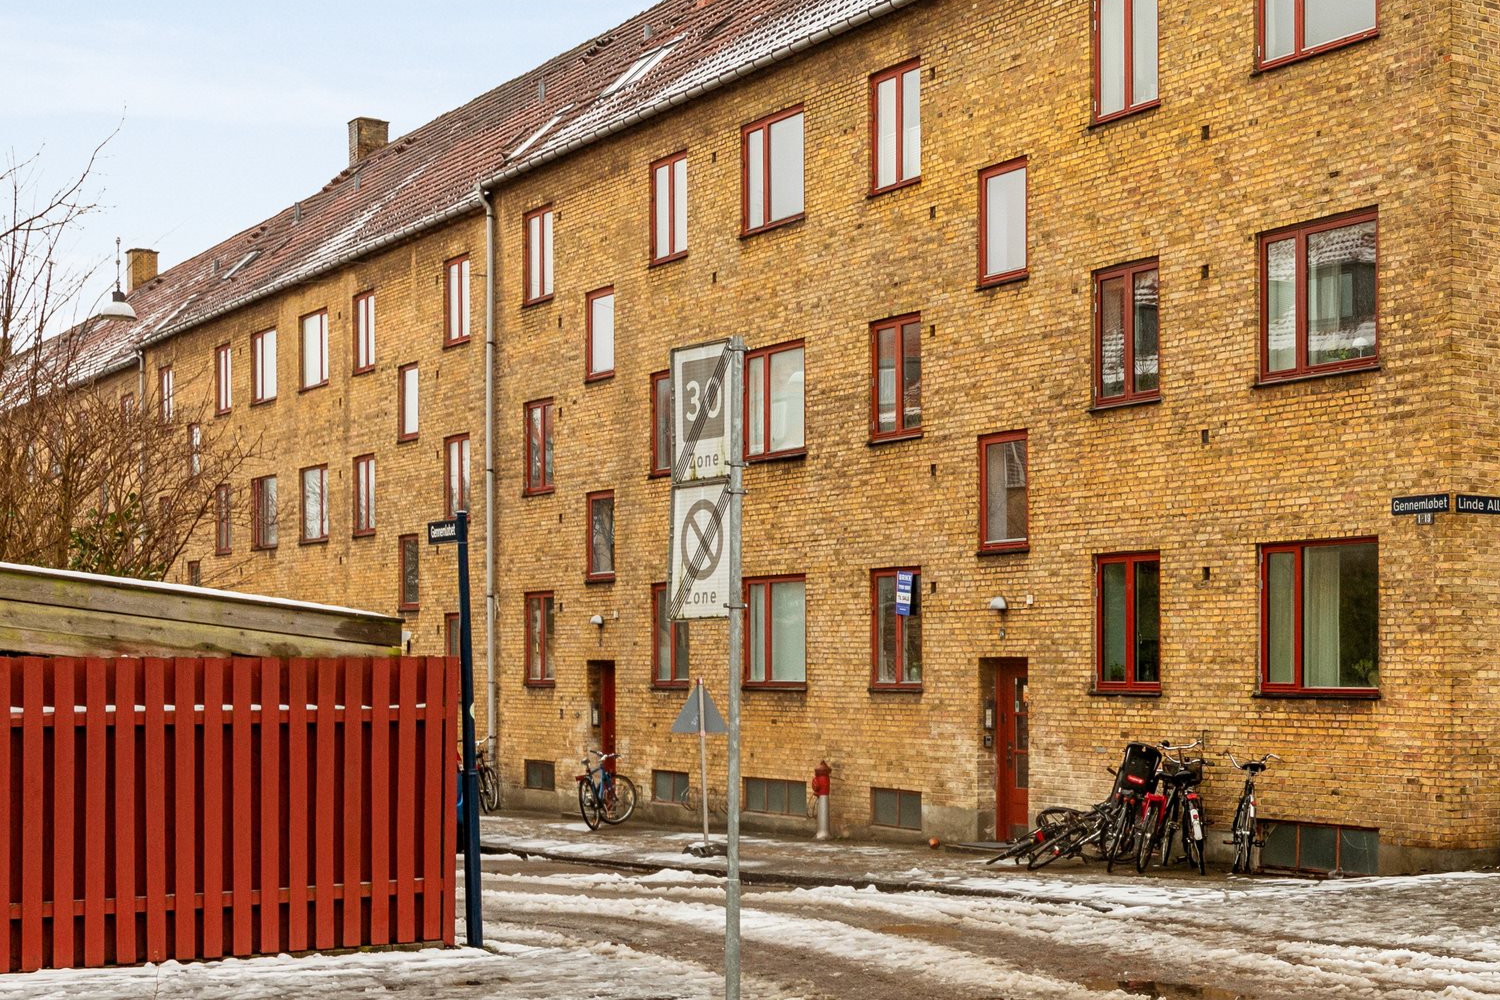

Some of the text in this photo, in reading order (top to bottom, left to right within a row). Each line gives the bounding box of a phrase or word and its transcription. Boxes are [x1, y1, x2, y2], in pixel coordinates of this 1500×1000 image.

[685, 375, 722, 422] 30
[1393, 497, 1448, 511] Gennemløbet
[1458, 498, 1484, 510] Linde
